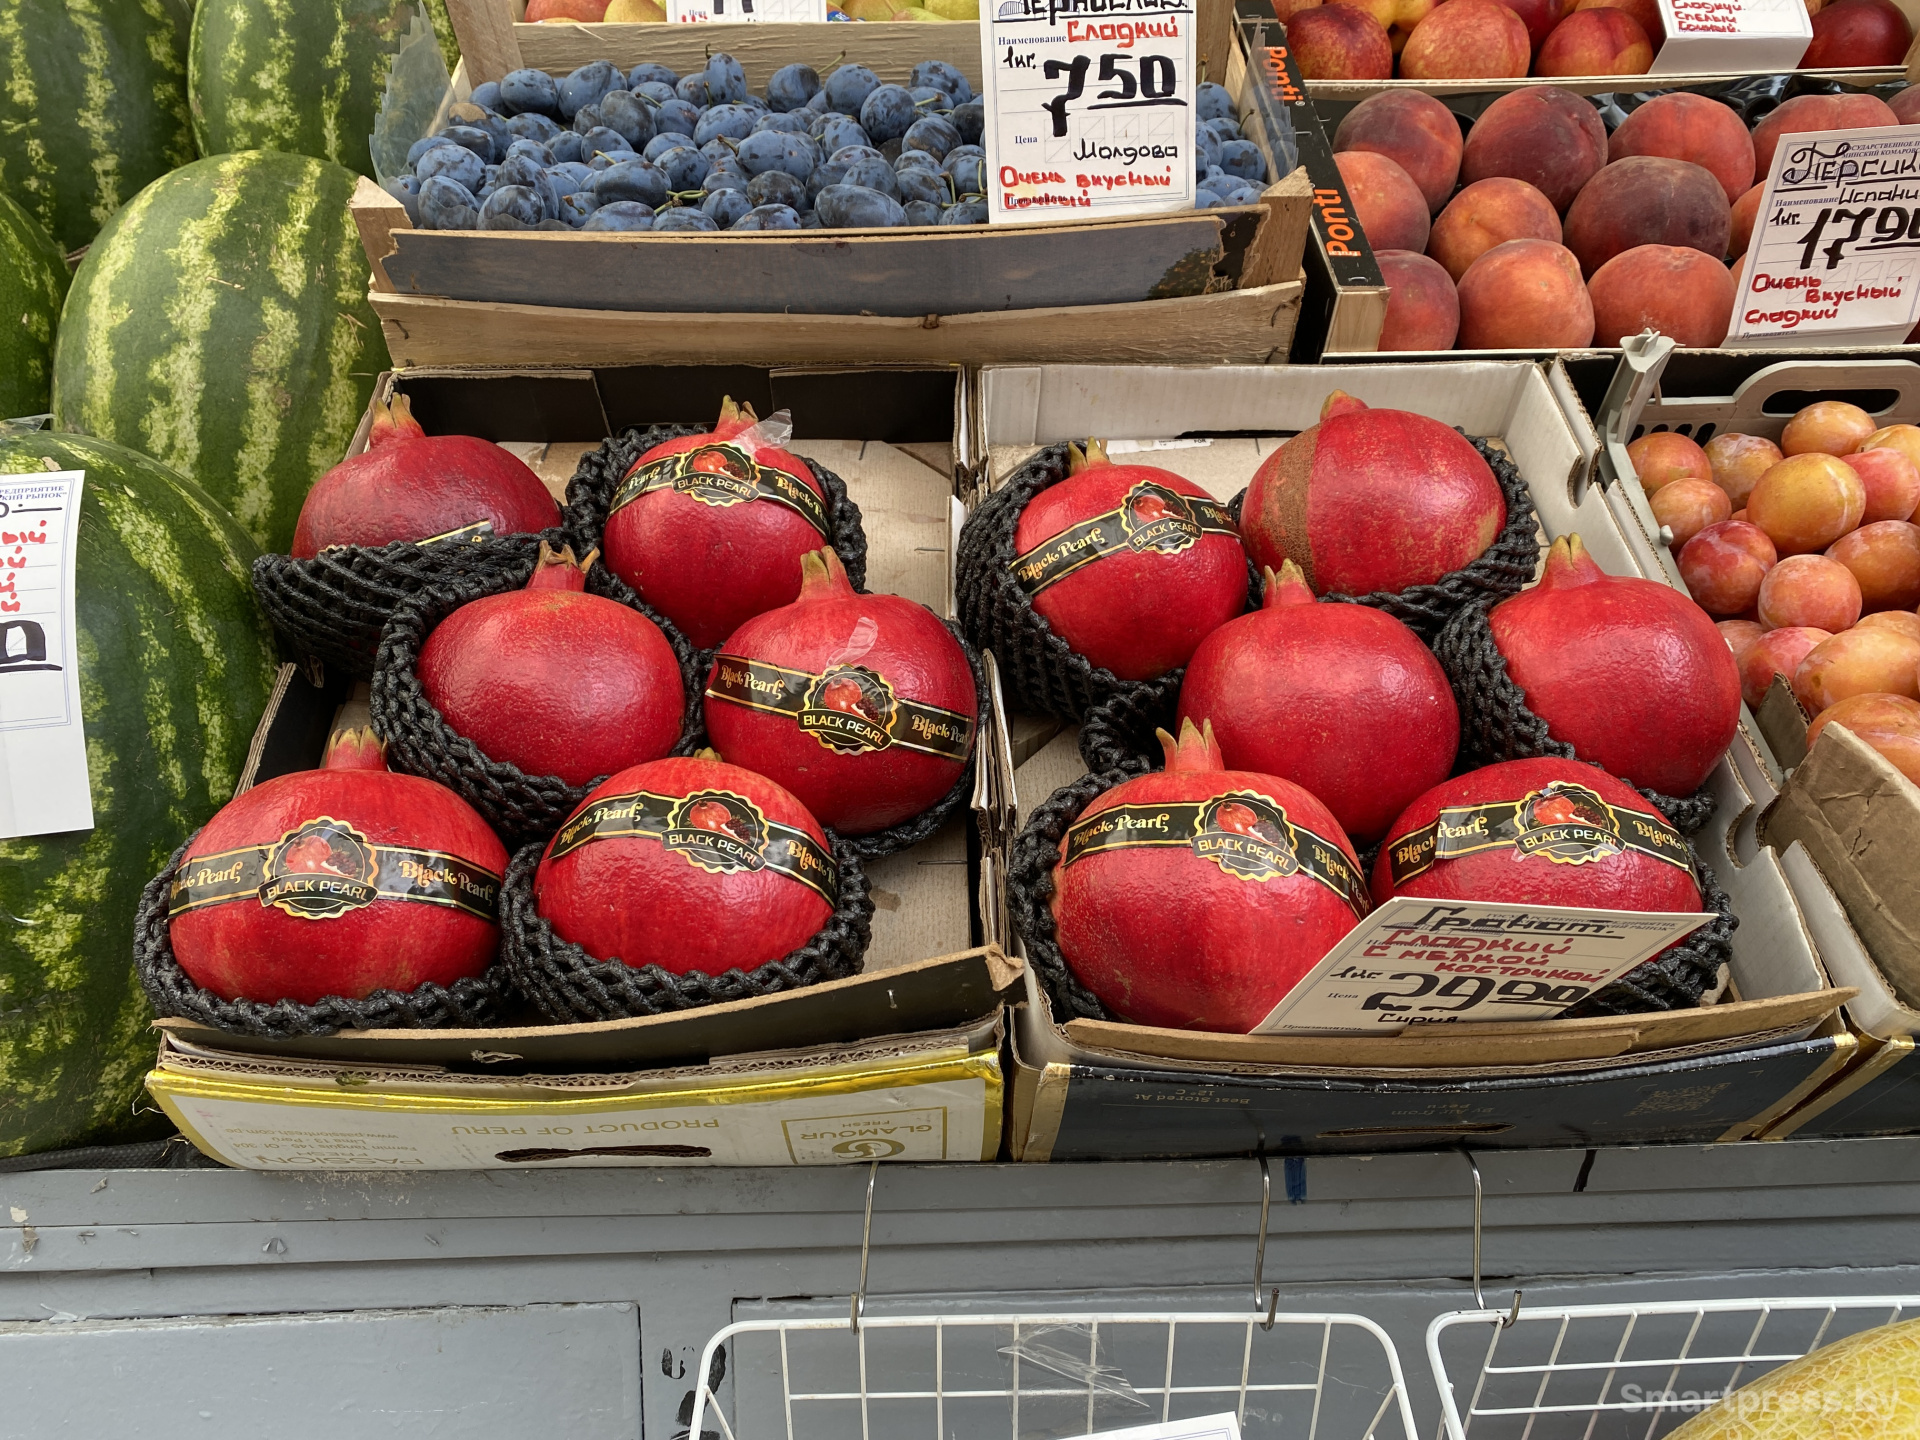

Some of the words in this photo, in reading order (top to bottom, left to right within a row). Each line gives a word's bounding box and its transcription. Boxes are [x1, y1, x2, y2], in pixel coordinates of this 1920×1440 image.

[998, 36, 1067, 46] Наименование
[1067, 16, 1179, 48] Сладкий
[1014, 136, 1038, 145] Цена
[1000, 165, 1066, 188] Очень
[1774, 197, 1839, 207] Наименование
[1751, 273, 1822, 293] Очень
[677, 474, 715, 488] BLACK
[716, 478, 752, 499] PEARL
[775, 475, 813, 509] Black
[1134, 522, 1167, 548] BLACK
[1168, 521, 1200, 537] PEARL
[1018, 550, 1061, 582] Black
[1057, 526, 1106, 560] Pearl
[721, 664, 744, 689] Black
[743, 671, 785, 701] Pearl
[803, 713, 844, 729] BLACK
[846, 720, 884, 747] PEARL
[911, 713, 951, 740] Black
[560, 814, 593, 844] Black
[593, 801, 645, 823] Pearl
[1073, 820, 1113, 848] Black
[1113, 812, 1171, 833] Pearl
[1436, 816, 1489, 840] Pearl
[1522, 828, 1570, 849] BLACK
[1632, 820, 1682, 850] Black
[668, 833, 715, 848] BLACK
[716, 838, 758, 868] PEARL
[786, 839, 827, 877] Black
[1198, 838, 1243, 851] BLACK
[1246, 844, 1292, 872] PEARL
[196, 861, 244, 887] Pearl
[1311, 844, 1351, 884] Black
[266, 878, 315, 900] BLACK
[318, 881, 369, 902] PEARL
[398, 860, 458, 889] Black
[457, 872, 493, 907] Pearl
[1384, 929, 1574, 955] Сладкий
[1398, 948, 1550, 967] мелкой
[1434, 962, 1611, 983] косточкой
[1134, 1093, 1153, 1101] At
[1156, 1094, 1211, 1103] Stored
[451, 1126, 527, 1135] PERU
[537, 1126, 573, 1135] OF
[584, 1119, 719, 1135] PRODUCT
[800, 1124, 932, 1140] GLAMOUR
[842, 1120, 890, 1128] FRESH
[256, 1155, 424, 1165] PASSION
